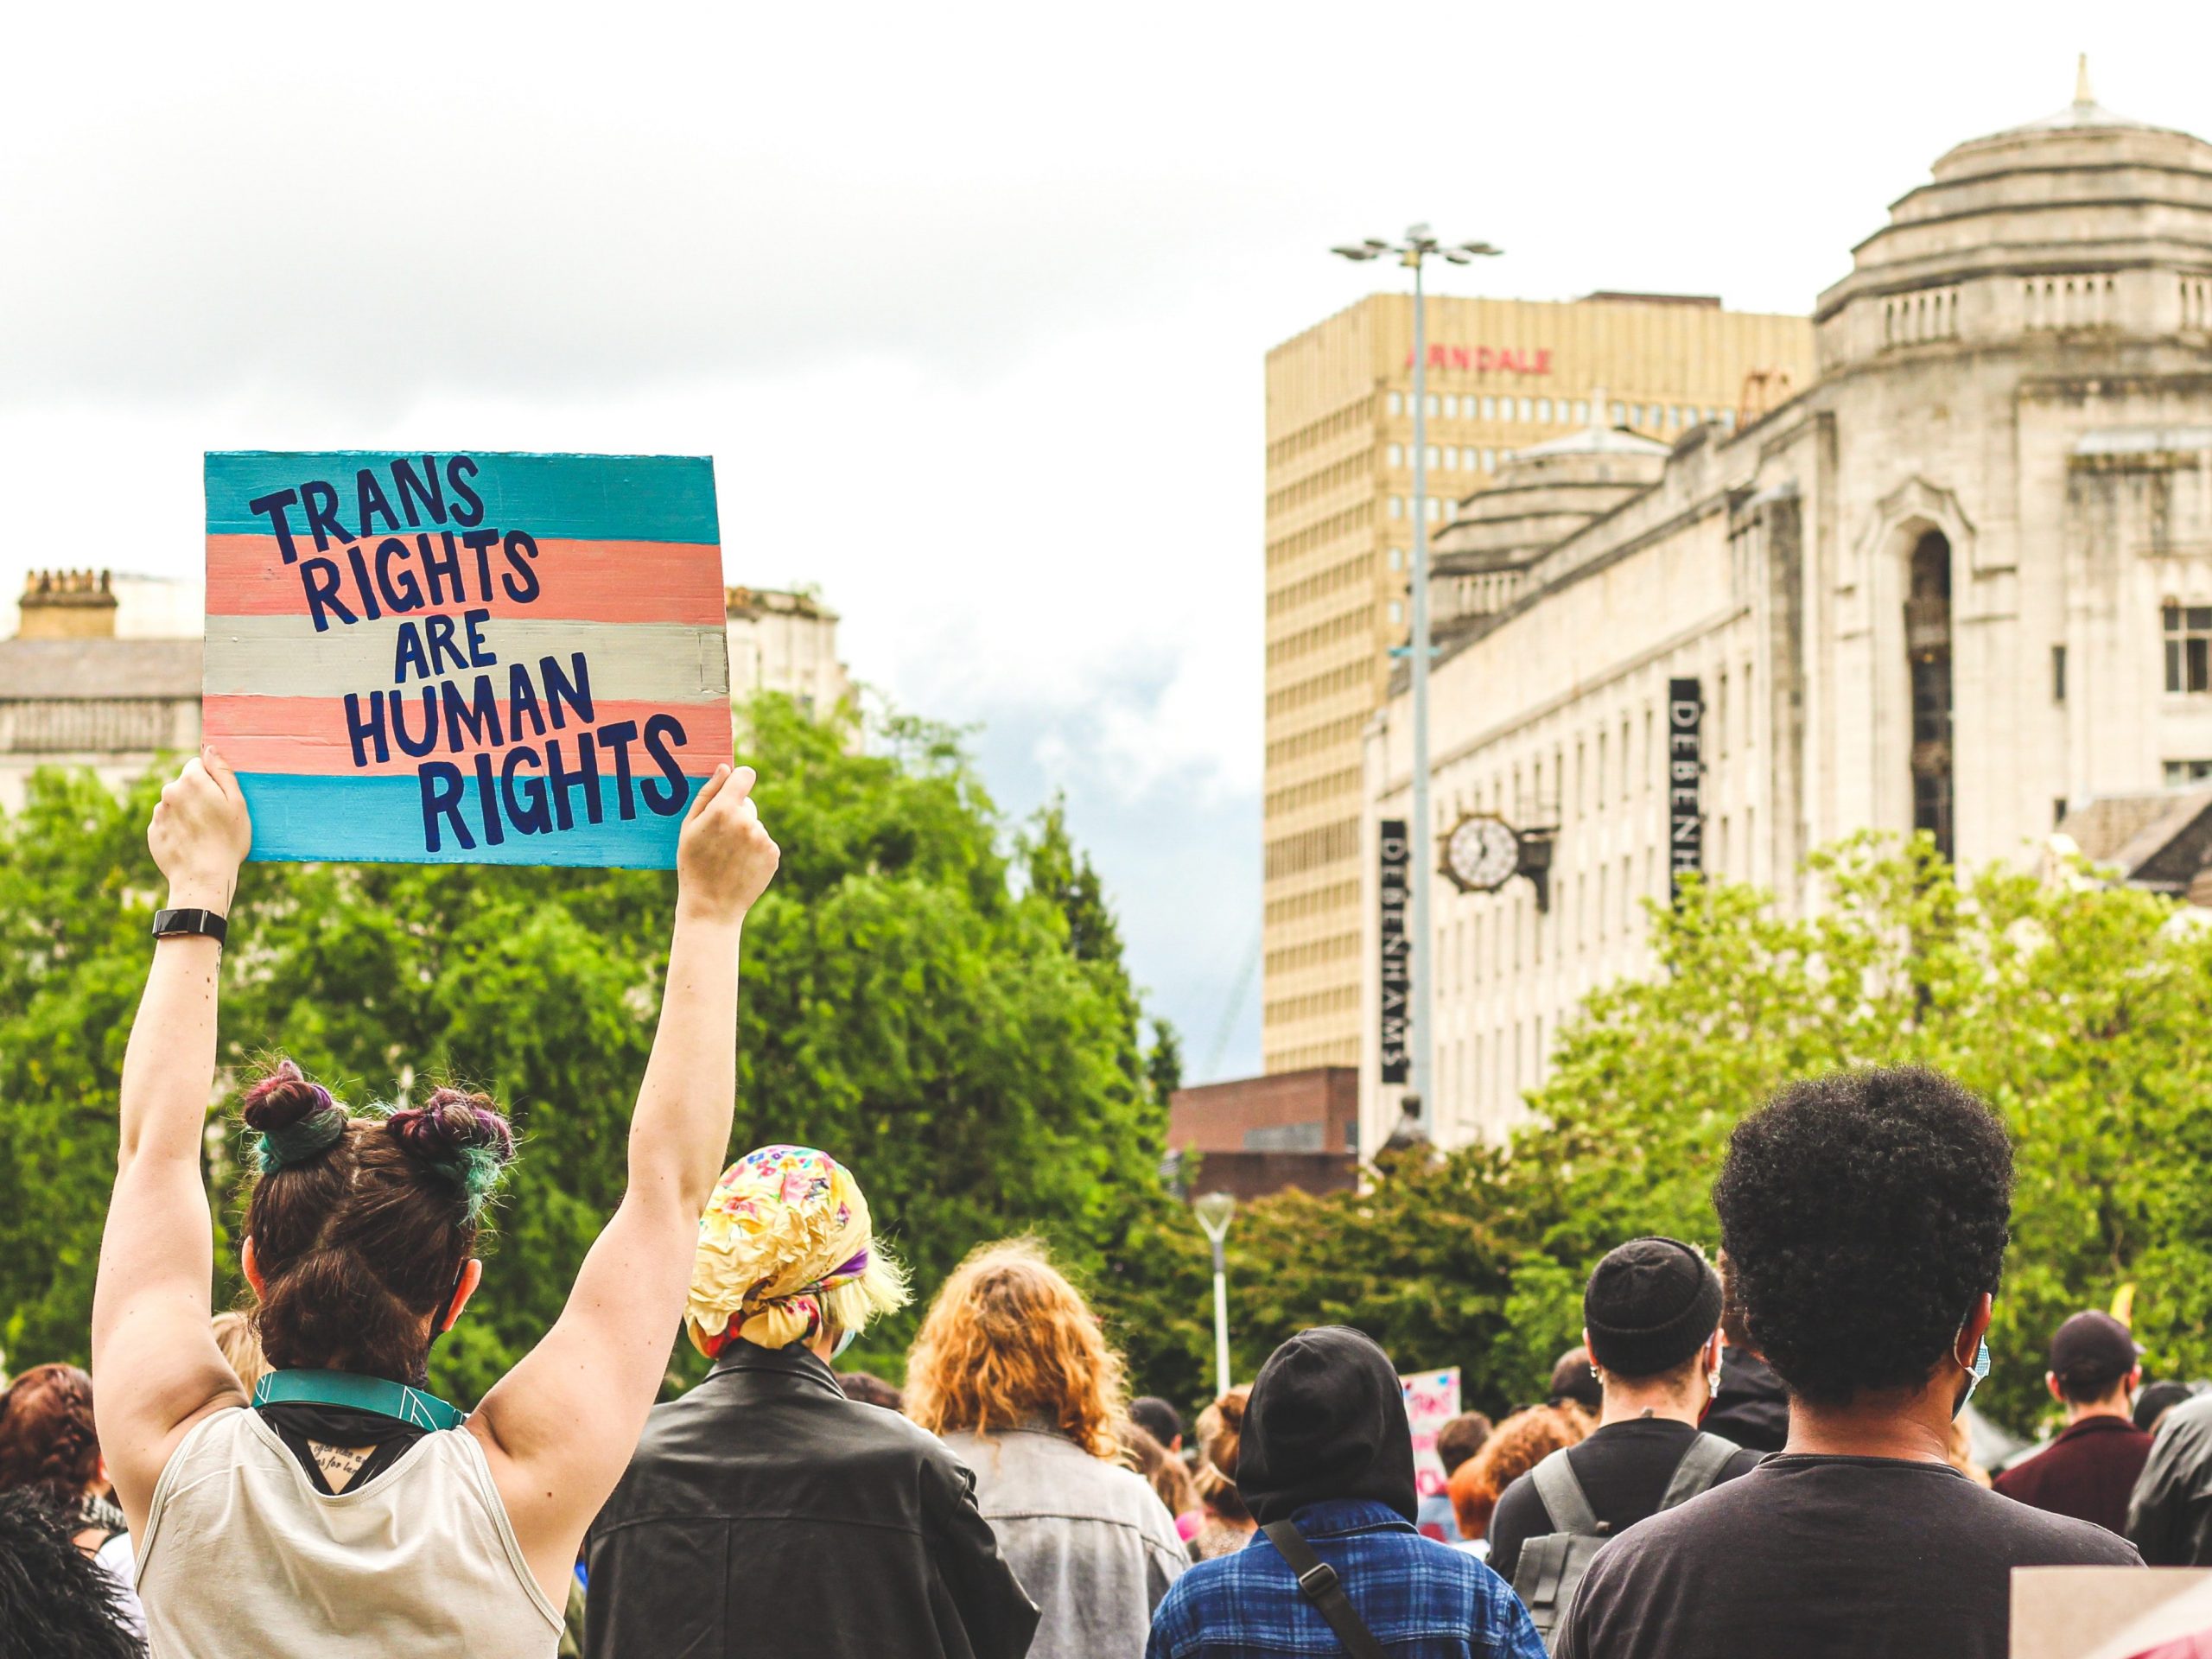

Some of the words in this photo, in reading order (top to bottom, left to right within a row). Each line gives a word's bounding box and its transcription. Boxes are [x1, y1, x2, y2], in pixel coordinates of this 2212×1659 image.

[249, 455, 484, 564] TRANS
[299, 529, 540, 632] RIGHTS
[394, 608, 498, 683] ARE
[343, 652, 594, 767] HUMAN
[418, 714, 690, 853] RIGHTS
[1382, 837, 1407, 1065] DEBENHAMS
